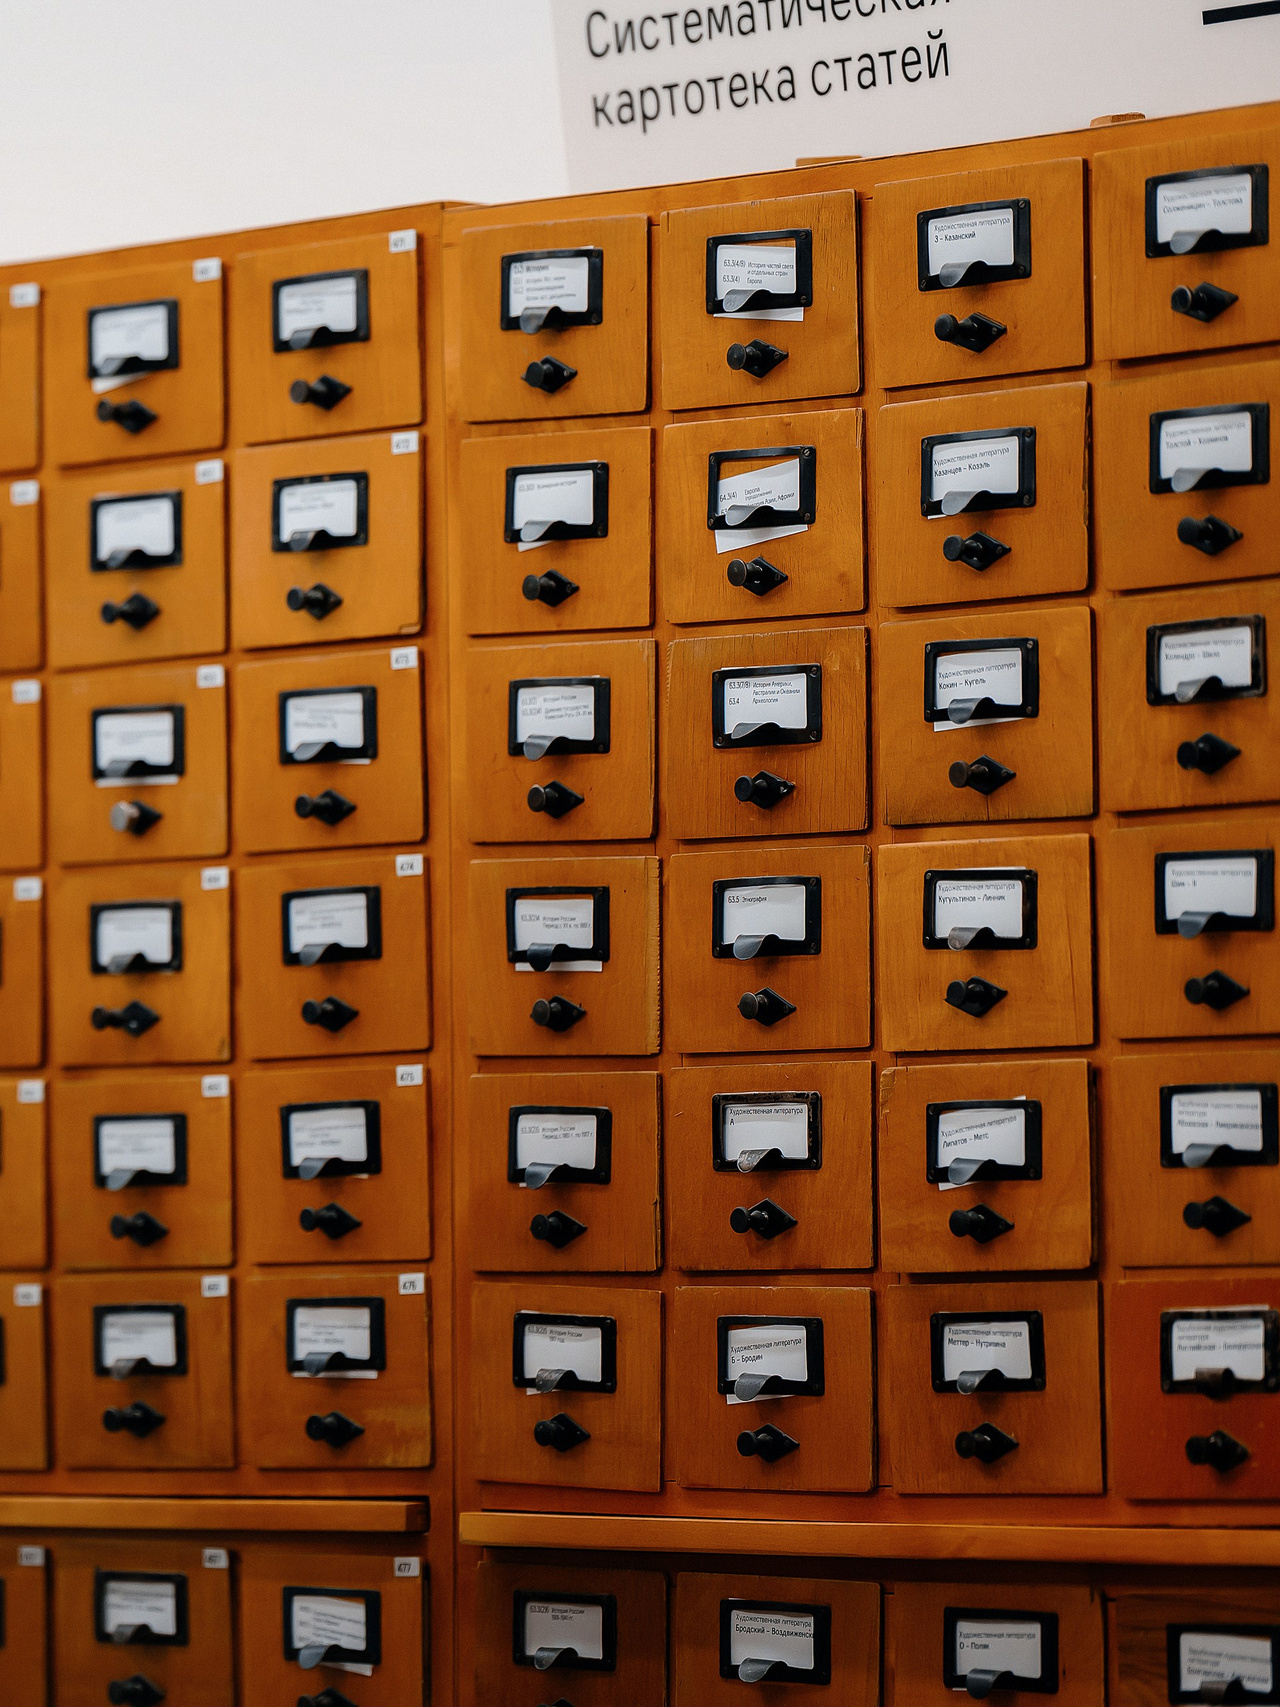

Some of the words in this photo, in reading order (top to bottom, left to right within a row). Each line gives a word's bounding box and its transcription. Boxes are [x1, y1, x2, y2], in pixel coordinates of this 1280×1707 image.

[586, 0, 949, 59] Систематиче
[592, 64, 797, 133] картотека
[811, 28, 950, 97] статей
[934, 220, 977, 232] Художественная
[978, 217, 1010, 226] литература
[944, 231, 976, 242] Казанский
[933, 453, 977, 466] Художественная
[979, 447, 1009, 458] литература
[934, 466, 962, 477] Казанцев
[744, 487, 760, 495] Европа
[938, 667, 984, 679] Художественная
[985, 662, 1016, 672] литература
[939, 682, 958, 690] Кокин
[964, 678, 986, 688] Кугель
[941, 1122, 986, 1138] Художественная
[986, 1116, 1017, 1127] литература
[943, 1137, 967, 1148] Липатов
[730, 1342, 772, 1353] Художественная
[773, 1338, 802, 1347] литература
[948, 1338, 969, 1347] Меттер
[741, 1354, 763, 1363] Бродин
[736, 1614, 781, 1624] Художественная
[781, 1619, 811, 1628] литература
[736, 1624, 765, 1634] Бродский
